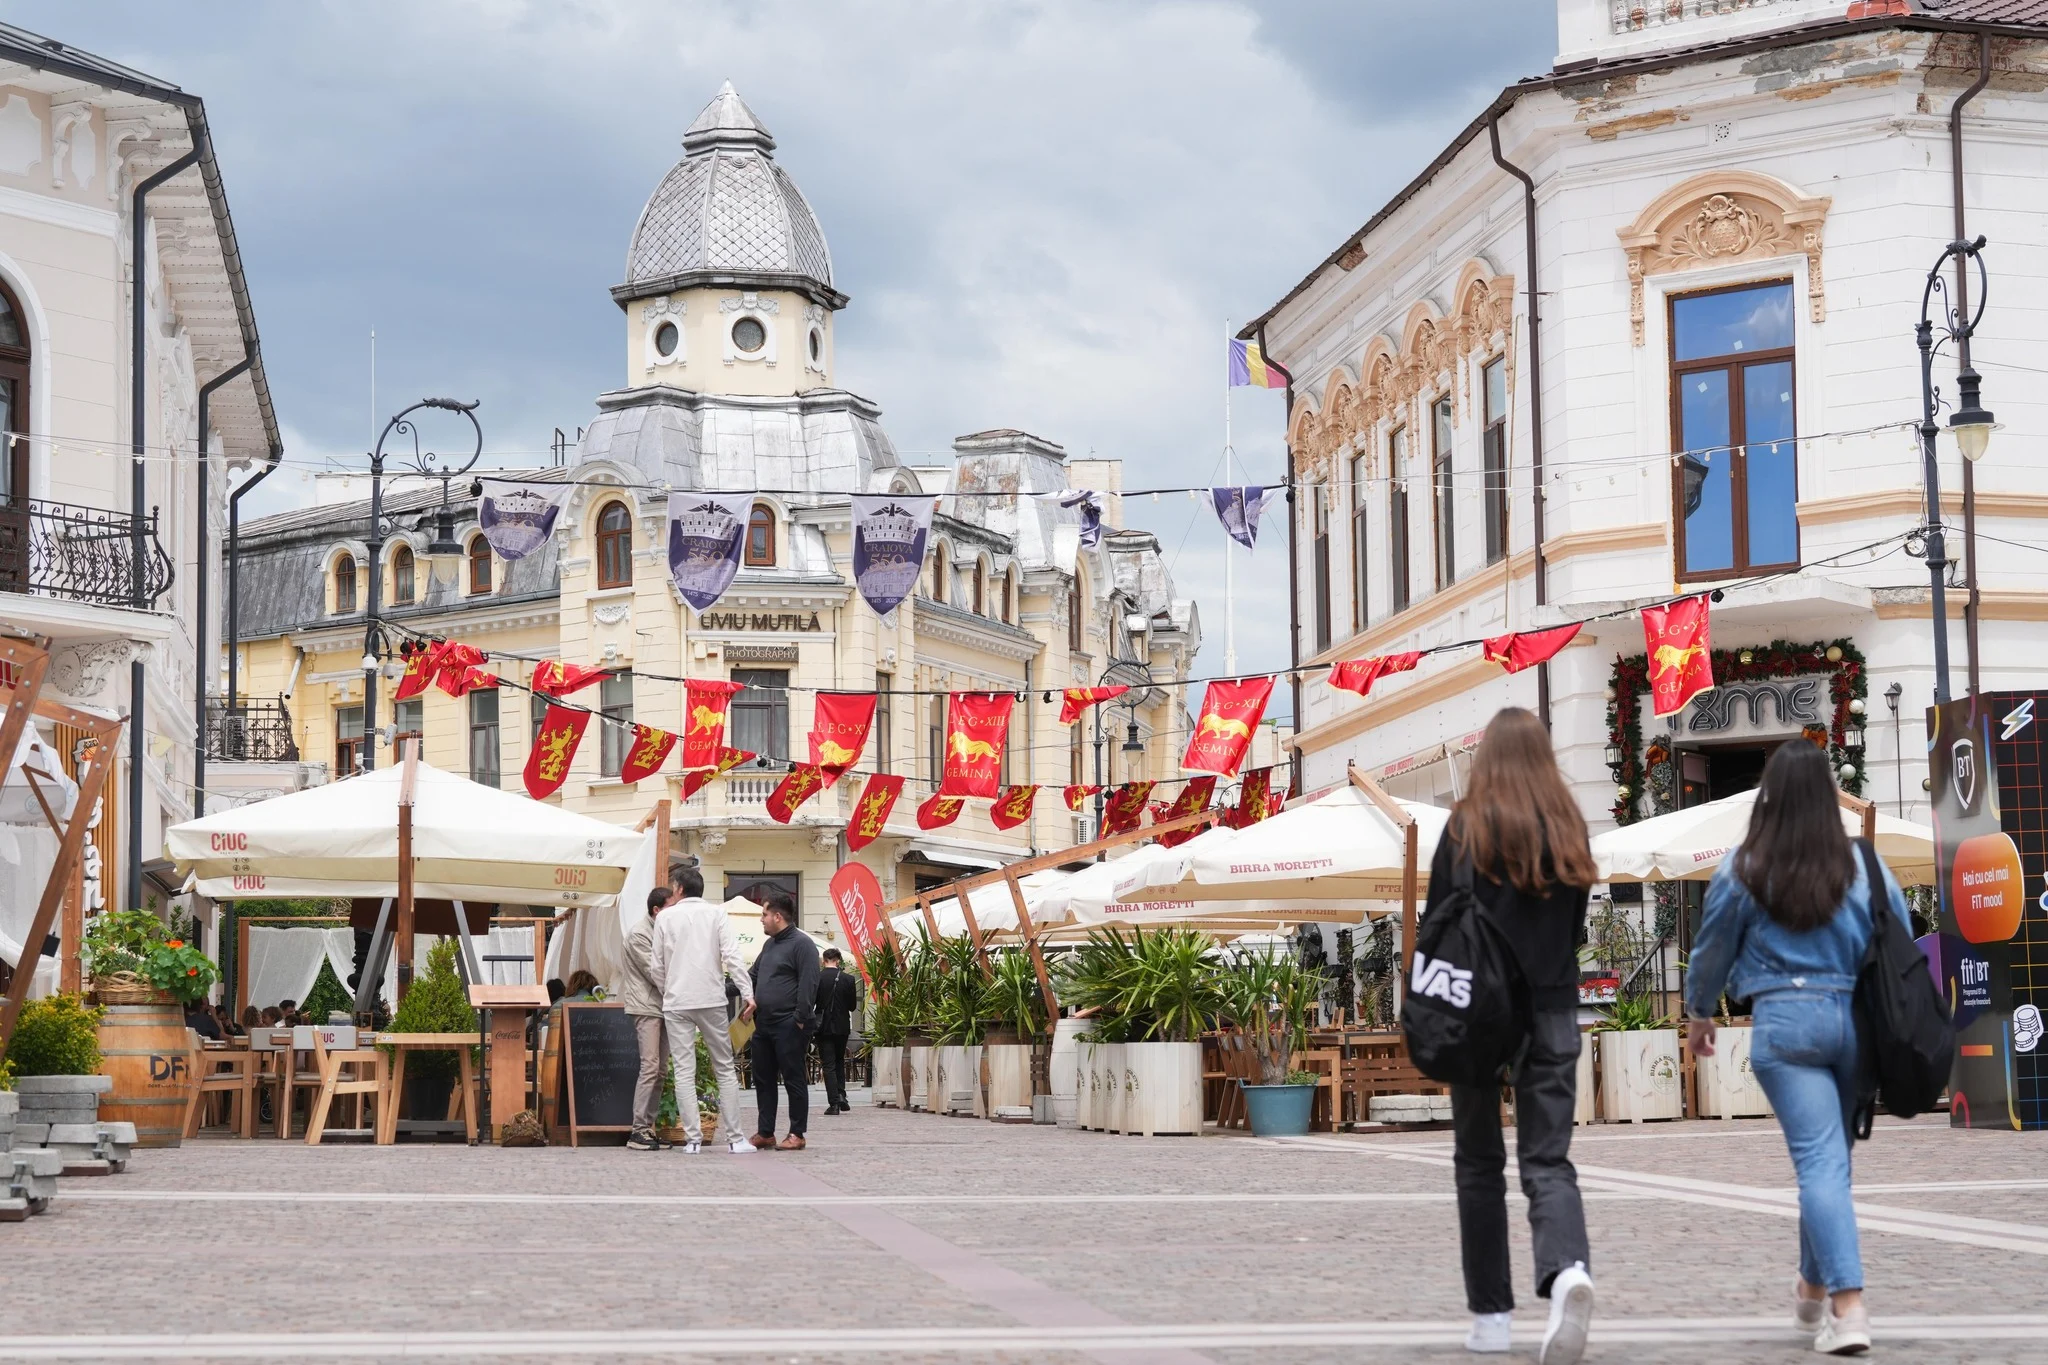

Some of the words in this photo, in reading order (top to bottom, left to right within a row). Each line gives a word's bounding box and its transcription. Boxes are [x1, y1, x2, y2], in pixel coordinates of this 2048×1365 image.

[681, 536, 732, 550] CRAIOVA
[864, 543, 914, 554] CRAIOVA
[700, 612, 747, 630] LIVIU
[751, 611, 822, 631] MUTILĂ
[726, 649, 797, 659] PHOTOGRAPHY
[946, 767, 993, 780] GEMINA
[1957, 756, 1971, 779] BT
[1230, 863, 1271, 874] BIRRA
[1274, 858, 1333, 872] MORETTI
[1962, 871, 1974, 887] Hai
[1975, 873, 1984, 885] cu
[1984, 868, 1995, 883] cel
[1995, 864, 2009, 881] mai
[1104, 903, 1141, 914] BIRRA
[1143, 900, 1195, 911] MORETTI
[1971, 894, 1983, 910] FIT
[1983, 891, 2003, 908] mood
